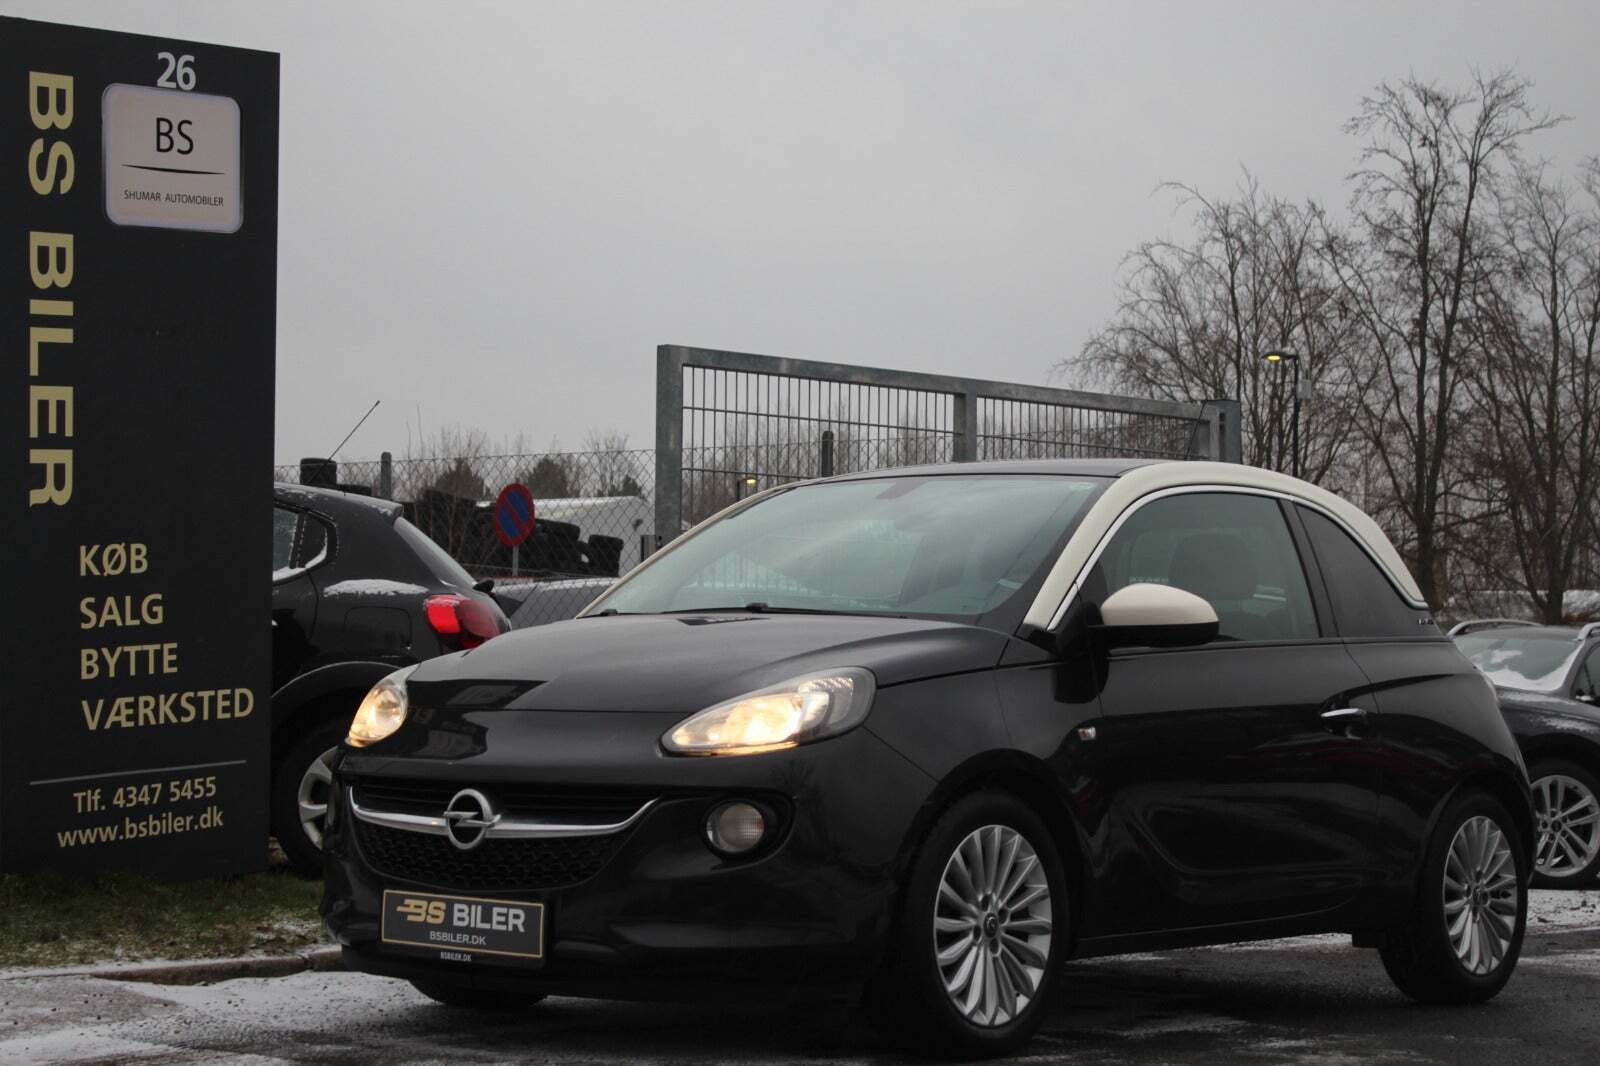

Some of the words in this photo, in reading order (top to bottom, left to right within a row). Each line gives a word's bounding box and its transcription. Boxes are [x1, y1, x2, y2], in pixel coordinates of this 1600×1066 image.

[156, 52, 196, 90] 26
[28, 71, 75, 195] BS
[155, 117, 194, 155] BS
[123, 189, 162, 202] SHUMAR
[164, 193, 224, 207] AUTOMOBILER
[29, 231, 74, 508] BILER
[79, 543, 148, 577] KØB
[80, 593, 164, 629] SALG
[80, 642, 178, 680] BYTTE
[81, 688, 254, 731] VÆRKSTED
[73, 788, 106, 814] Tlf.
[112, 783, 162, 809] 4347
[169, 776, 217, 802] 5455
[57, 805, 224, 848] www.bsbiler.dk
[396, 899, 446, 925] BS
[452, 903, 526, 933] BILER
[429, 930, 487, 946] BSBILER.DK
